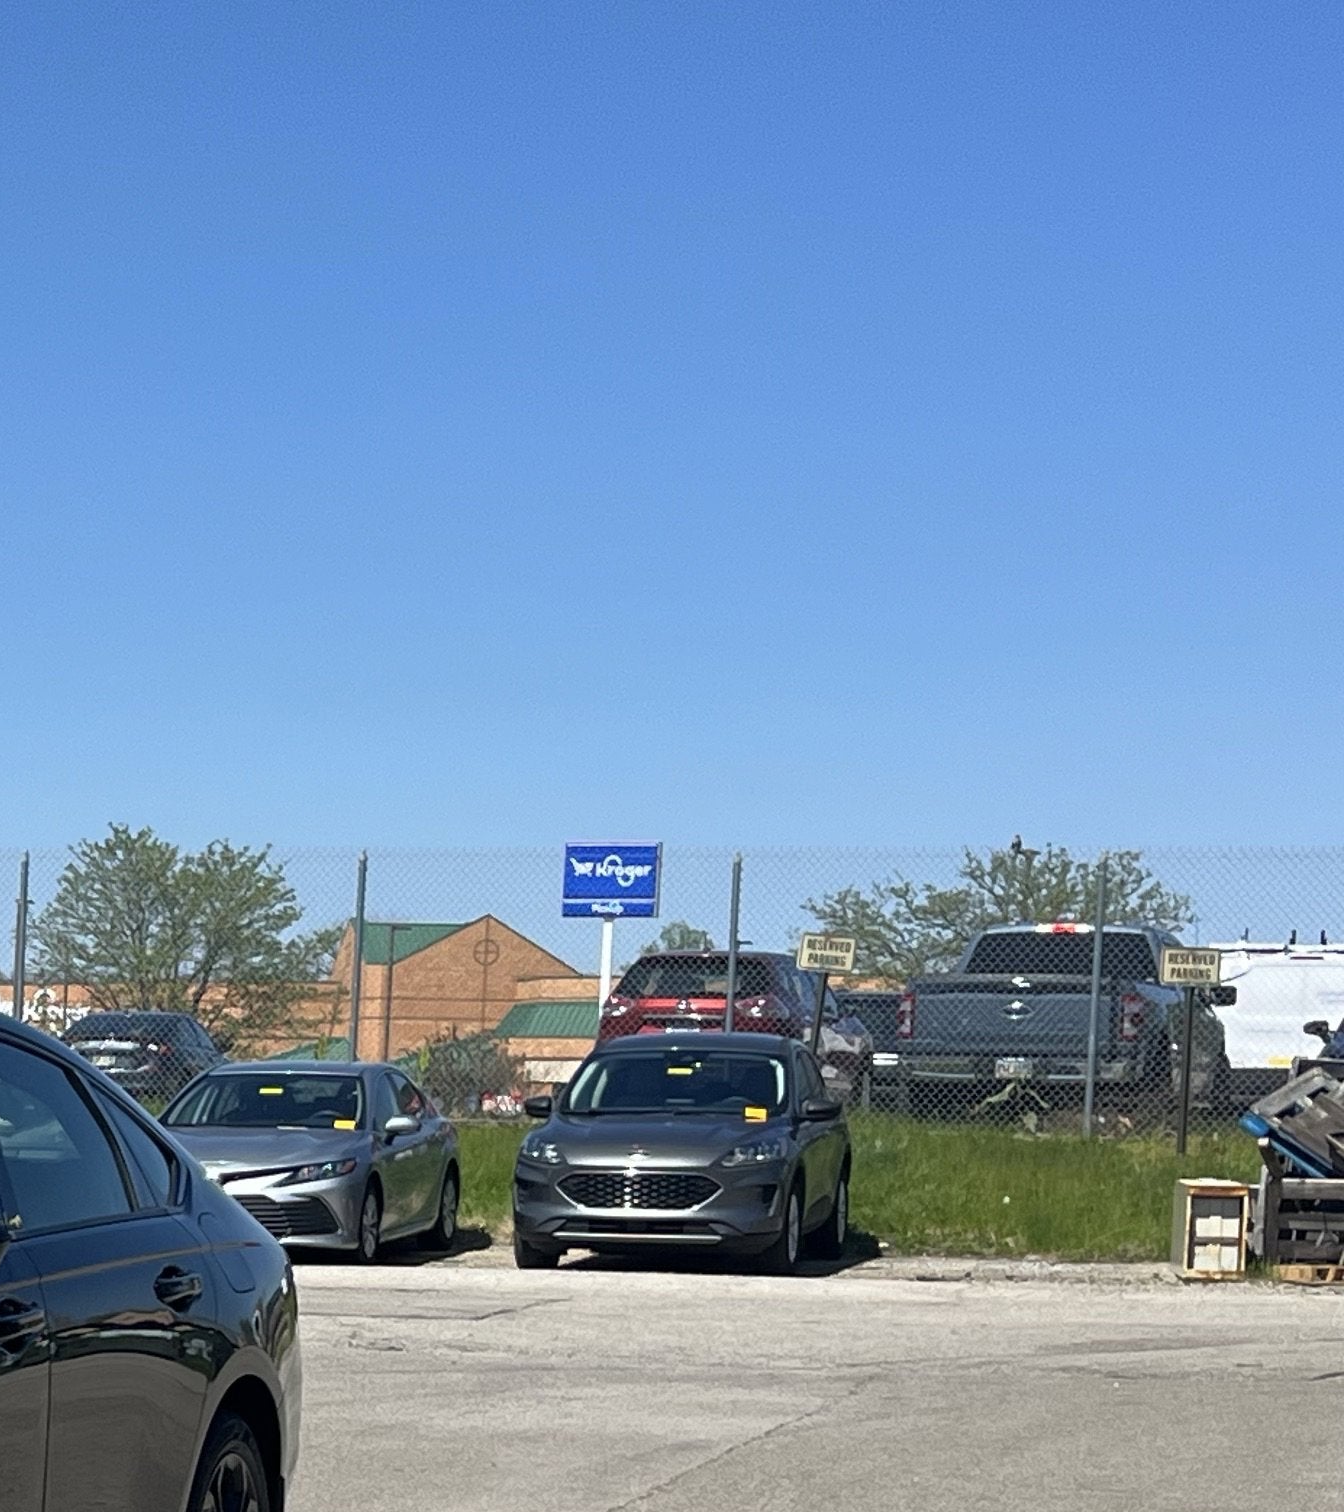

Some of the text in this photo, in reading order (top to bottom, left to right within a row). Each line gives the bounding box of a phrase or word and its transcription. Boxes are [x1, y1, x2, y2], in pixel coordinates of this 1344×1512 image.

[595, 854, 652, 887] Kroger
[1168, 952, 1215, 966] RESERVED
[1170, 967, 1212, 980] PARKING
